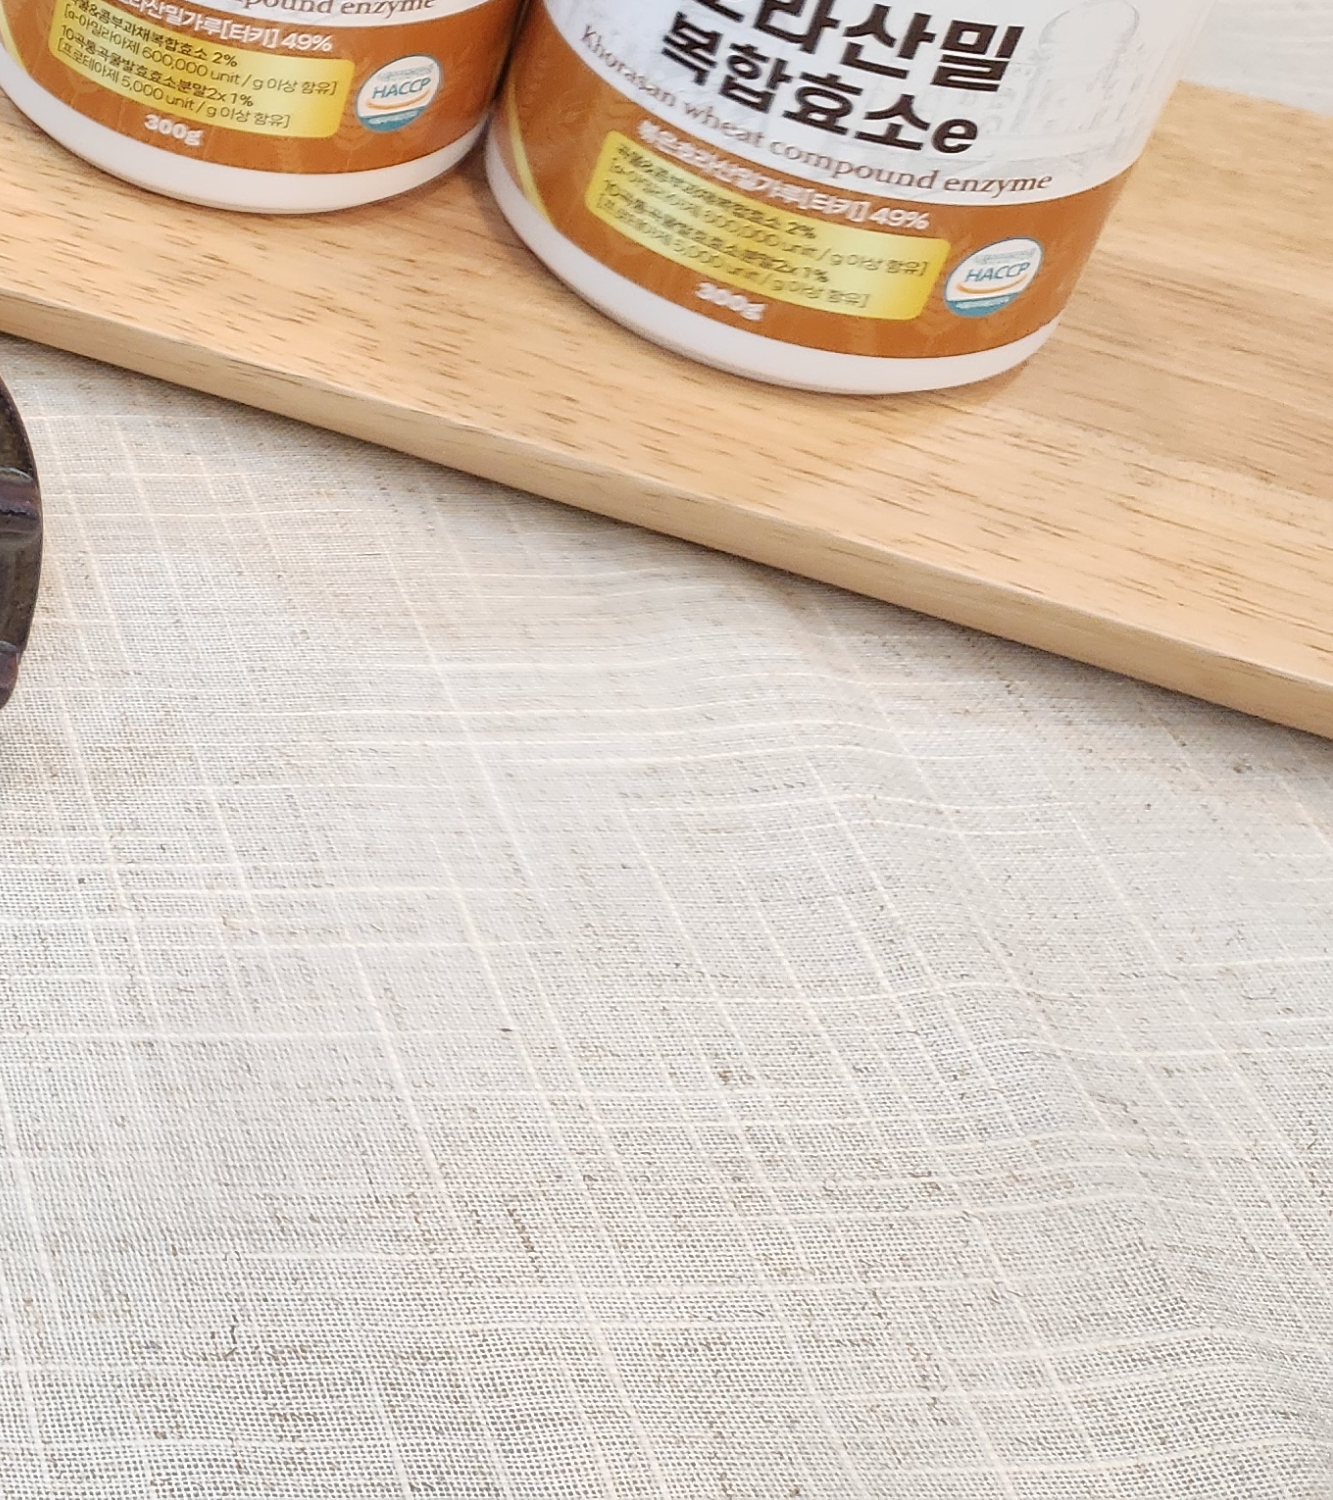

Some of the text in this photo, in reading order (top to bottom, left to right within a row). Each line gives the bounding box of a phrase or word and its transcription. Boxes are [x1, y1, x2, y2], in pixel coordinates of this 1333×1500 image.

[281, 32, 333, 52] 49%
[141, 45, 208, 77] 600,000
[213, 51, 238, 68] 2%
[372, 77, 431, 99] HACCP
[660, 10, 979, 155] 복합효소e
[580, 25, 677, 109] Khorasan
[684, 102, 766, 147] wheat
[770, 139, 939, 191] compound
[944, 174, 1052, 197] enzyme
[143, 114, 205, 146] 300g
[870, 207, 930, 230] 49%
[963, 261, 1031, 283] HACCP
